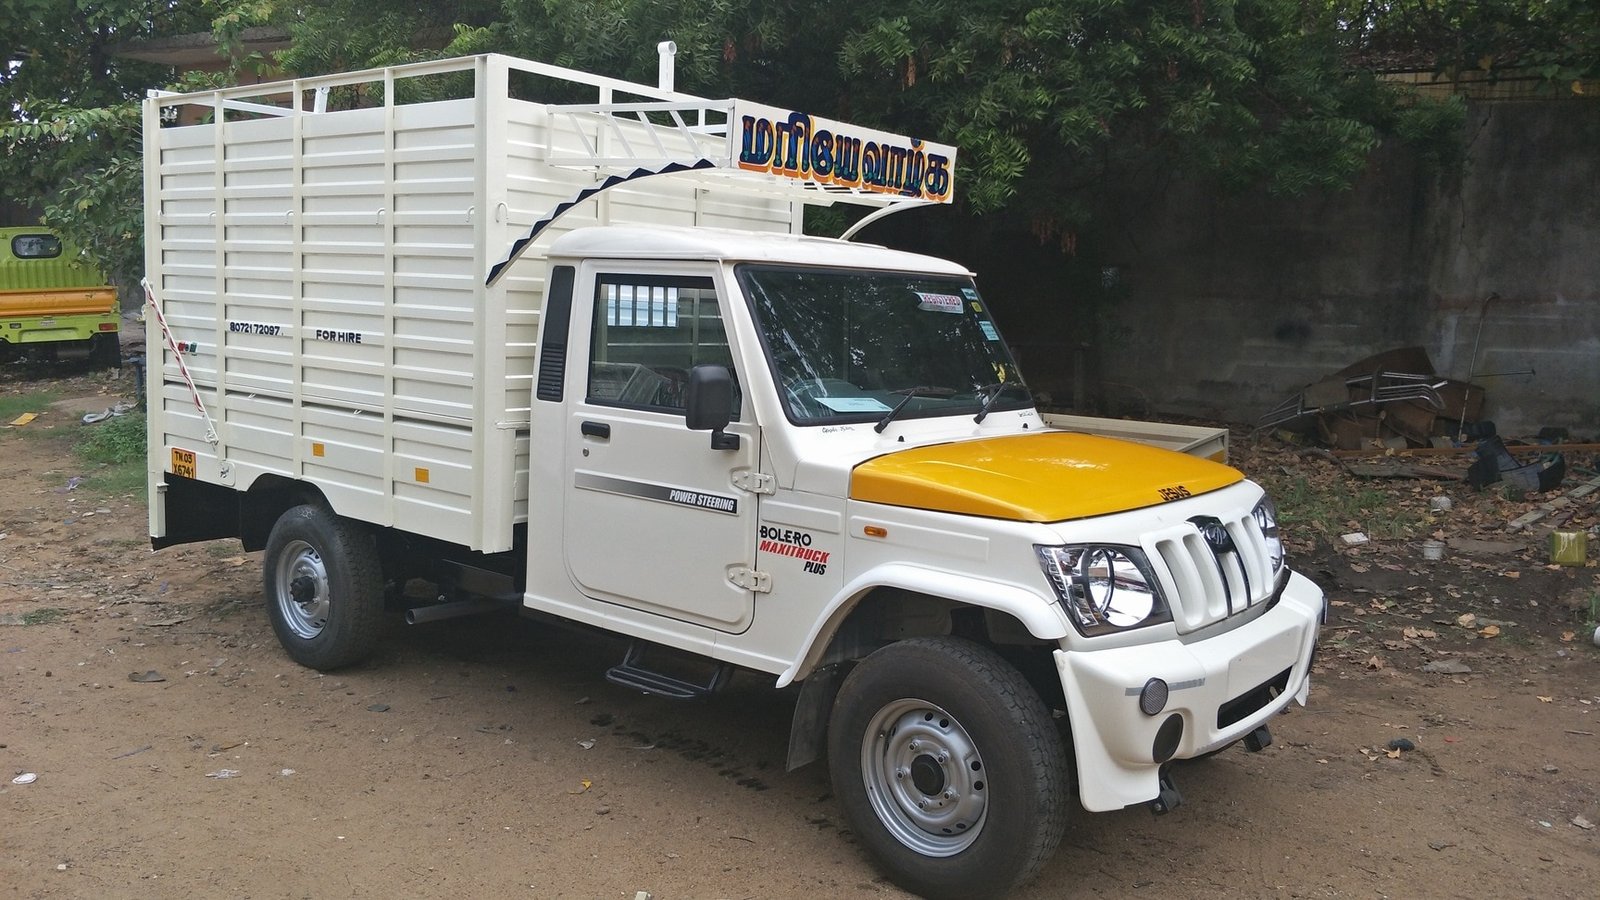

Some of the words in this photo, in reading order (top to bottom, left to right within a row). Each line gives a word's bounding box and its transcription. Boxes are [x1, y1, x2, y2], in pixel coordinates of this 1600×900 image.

[315, 329, 336, 341] FOR
[337, 331, 362, 344] HIRE
[669, 489, 697, 505] POWER
[697, 494, 735, 511] STEERING
[1157, 485, 1192, 501] JESUS
[759, 525, 812, 547] BOLERO
[759, 540, 831, 563] MAXITRUCK
[803, 561, 827, 575] PLUS
